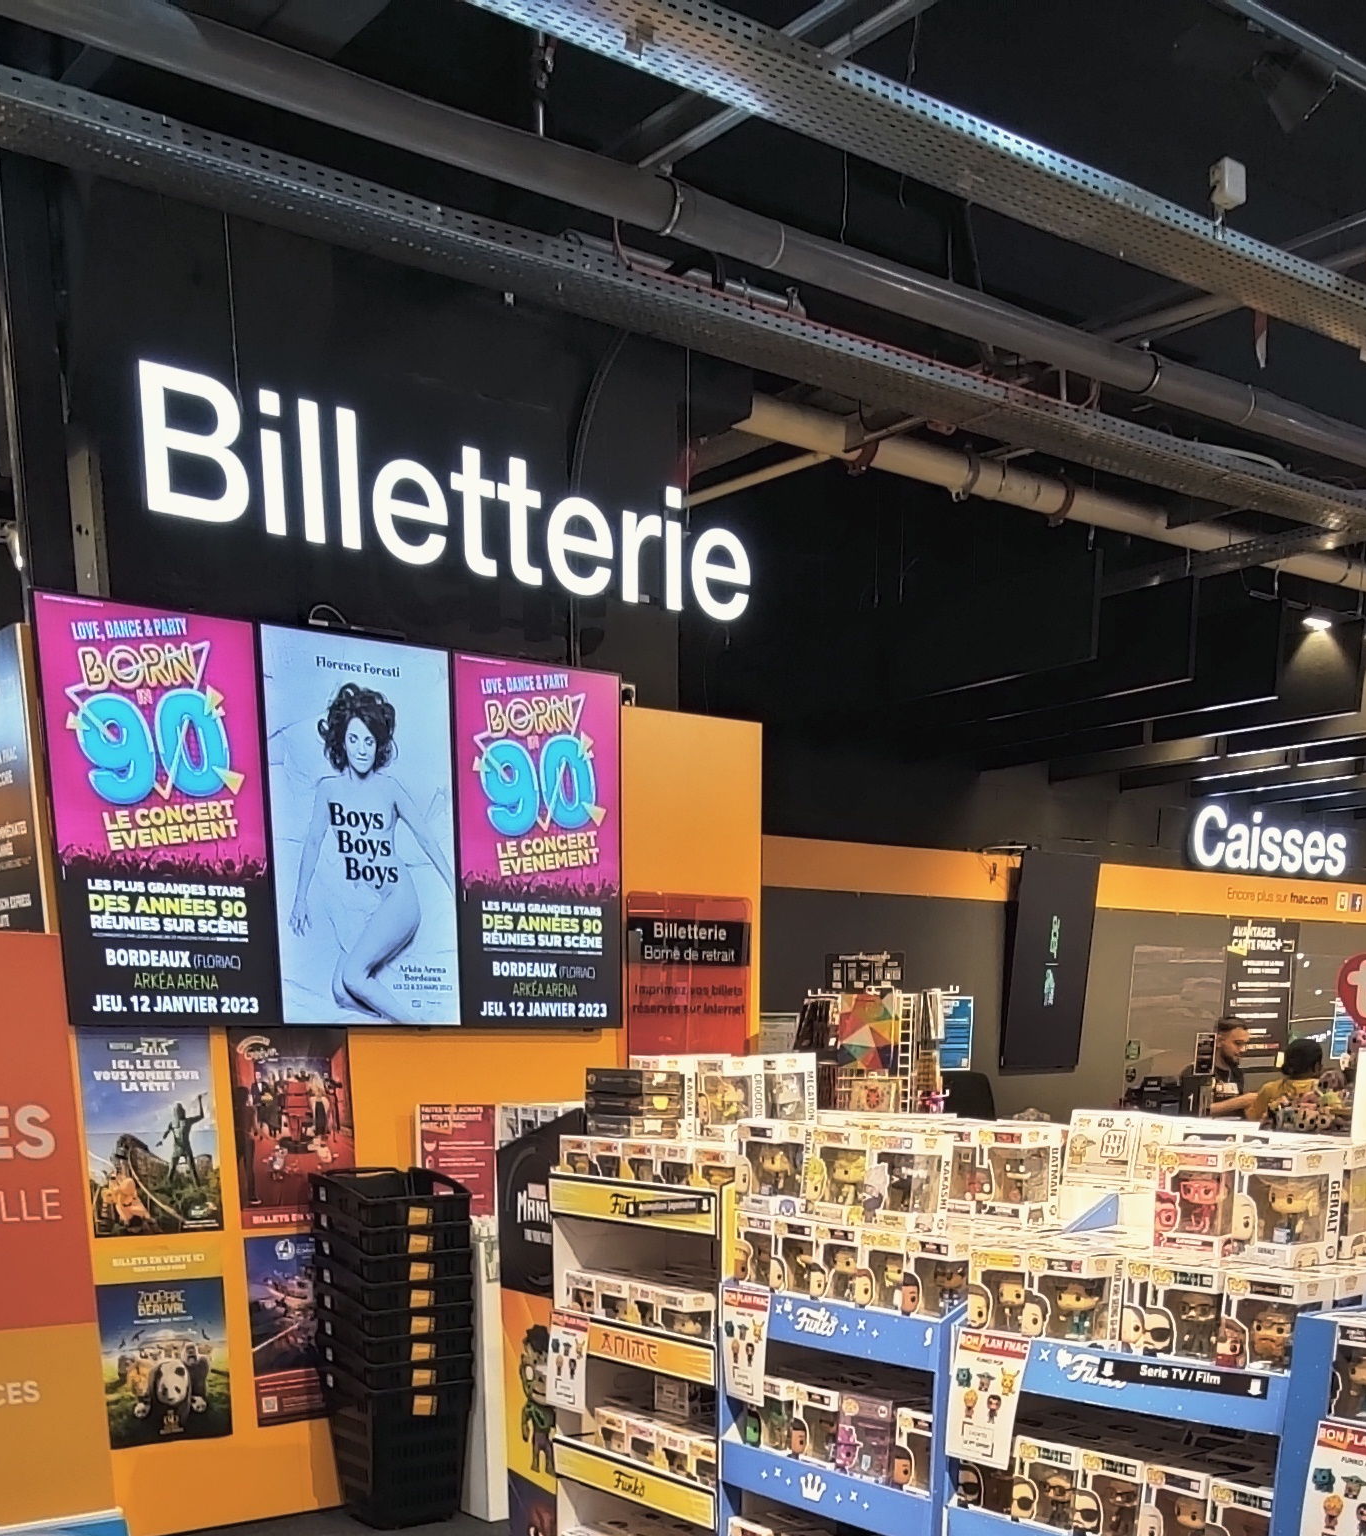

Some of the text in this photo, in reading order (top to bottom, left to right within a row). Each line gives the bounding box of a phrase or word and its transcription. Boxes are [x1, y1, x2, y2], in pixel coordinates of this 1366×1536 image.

[139, 358, 751, 621] Billetterie
[71, 617, 188, 642] LOVE, DANCE & PARTY
[78, 645, 199, 691] BORN
[315, 656, 400, 678] Florence Foresti
[484, 698, 575, 738] BORN
[77, 689, 231, 804] 90
[481, 735, 595, 836] 90
[103, 800, 235, 832] LE CONCERT
[330, 803, 383, 832] Boys
[107, 820, 238, 851] EVENEMENT
[337, 830, 391, 858] Boys
[497, 831, 597, 859] LE CONCERT
[1191, 805, 1348, 876] Caisses
[345, 857, 398, 888] Boys
[499, 849, 599, 877] EVENEMENT
[88, 879, 245, 898] LES PLUS GRANDES STARS
[1227, 887, 1328, 905] Encore plus sur fnac.com
[88, 892, 247, 917] DES ANNÉES 90
[90, 913, 249, 934] RÉUNIES SUR SCÈNE
[653, 922, 727, 940] Billetterie
[1050, 916, 1060, 959] acer
[106, 949, 191, 968] BORDEAUX
[644, 945, 735, 962] Borne de retrait
[134, 970, 219, 990] ARKÉA ARENA
[92, 994, 259, 1014] JEU. 12 JANVIER 2023
[94, 1070, 199, 1081] VOUS TOMBE SUR
[112, 1059, 180, 1071] ICI, LE CIEL
[121, 1082, 139, 1092] LA
[140, 1080, 169, 1092] TÊTE
[1327, 1180, 1340, 1234] GERALT
[112, 1254, 204, 1267] BILLETS EN VENTE ICI
[138, 1302, 186, 1317] BEAUVAL
[1140, 1364, 1221, 1386] Serie TV / Film
[1319, 1427, 1345, 1444] BON
[1341, 1456, 1364, 1468] FUNKO
